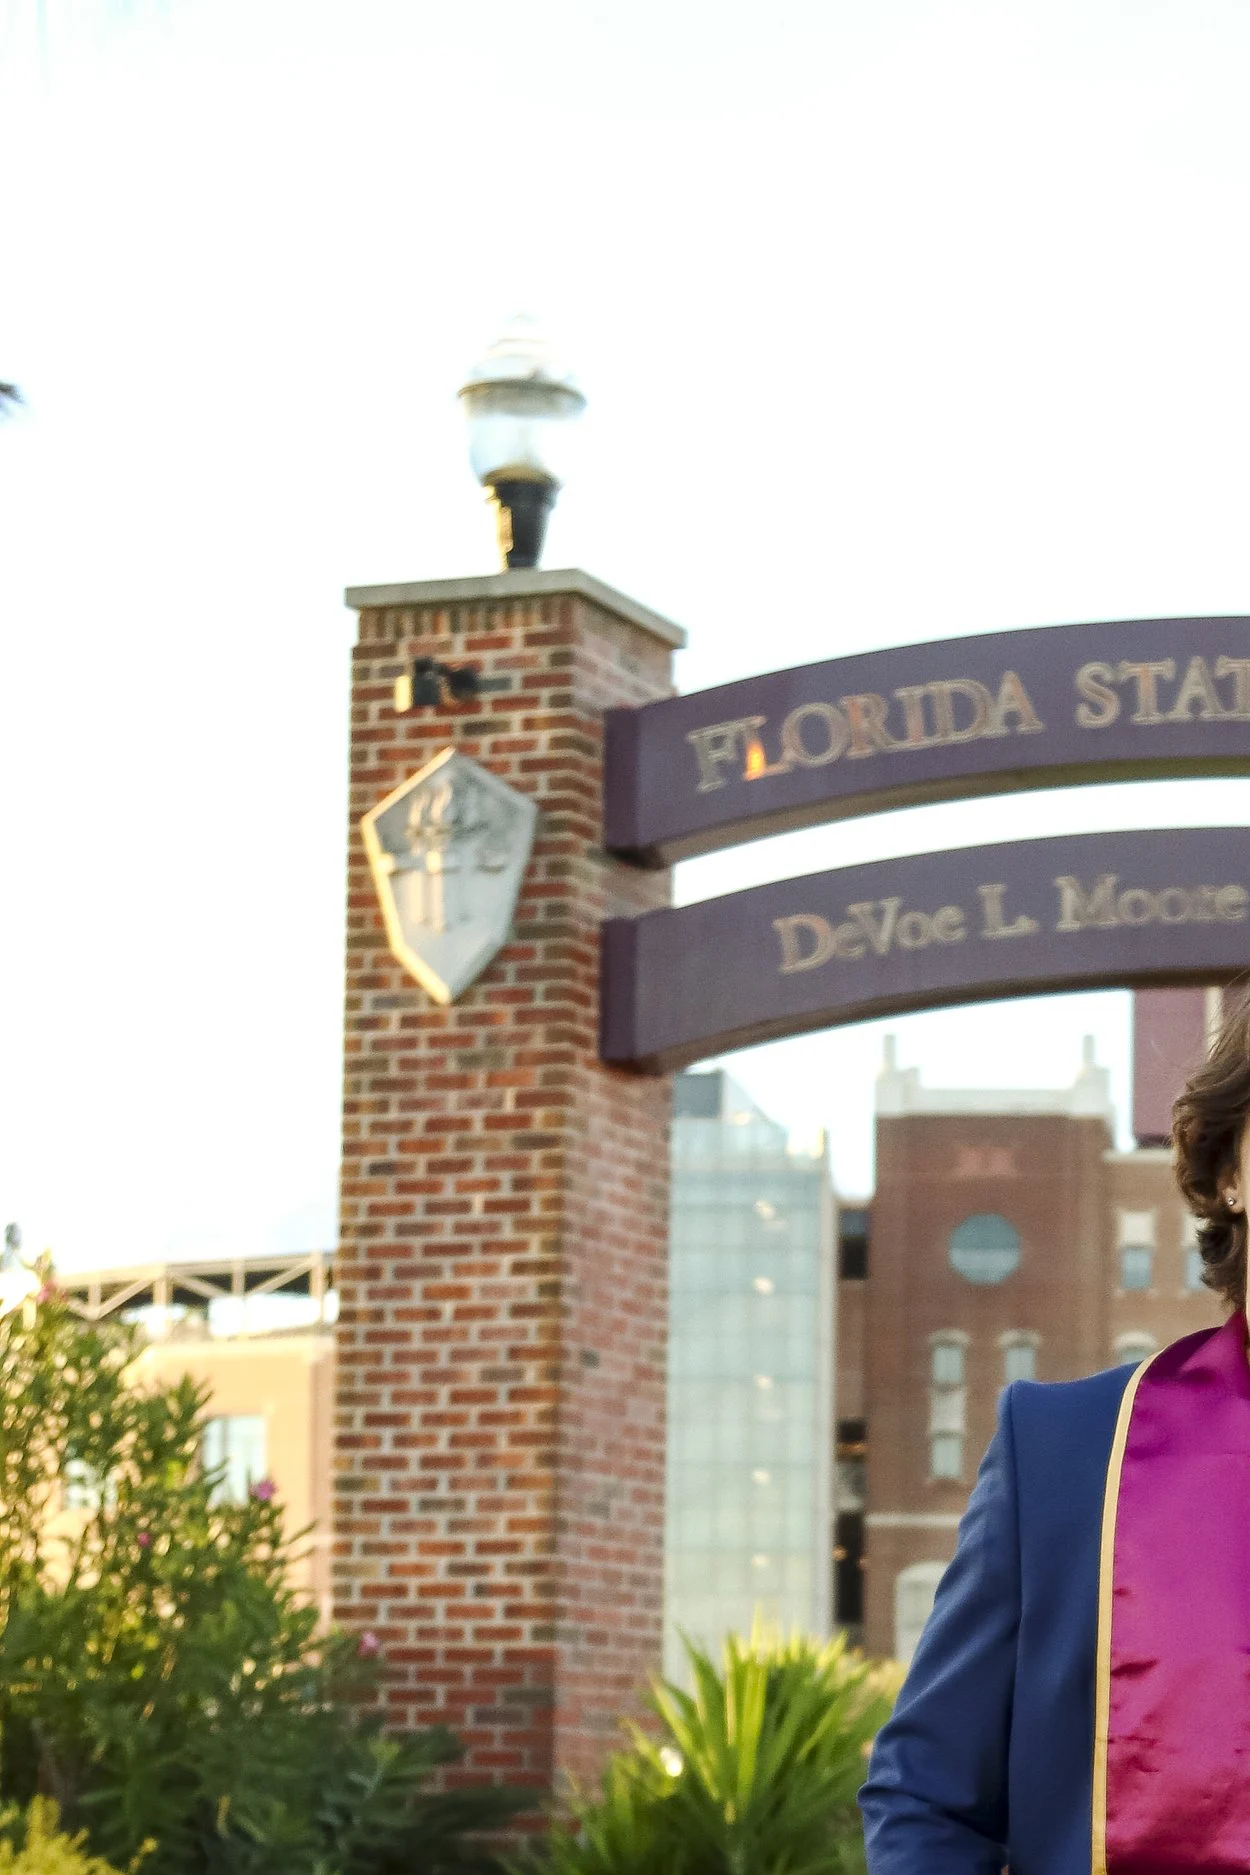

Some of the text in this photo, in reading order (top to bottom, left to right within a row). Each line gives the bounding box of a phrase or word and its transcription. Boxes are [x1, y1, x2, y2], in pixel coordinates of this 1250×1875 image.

[686, 671, 1044, 792] FLORIDA
[772, 897, 966, 976] DeVoe
[1055, 873, 1249, 933] Moore
